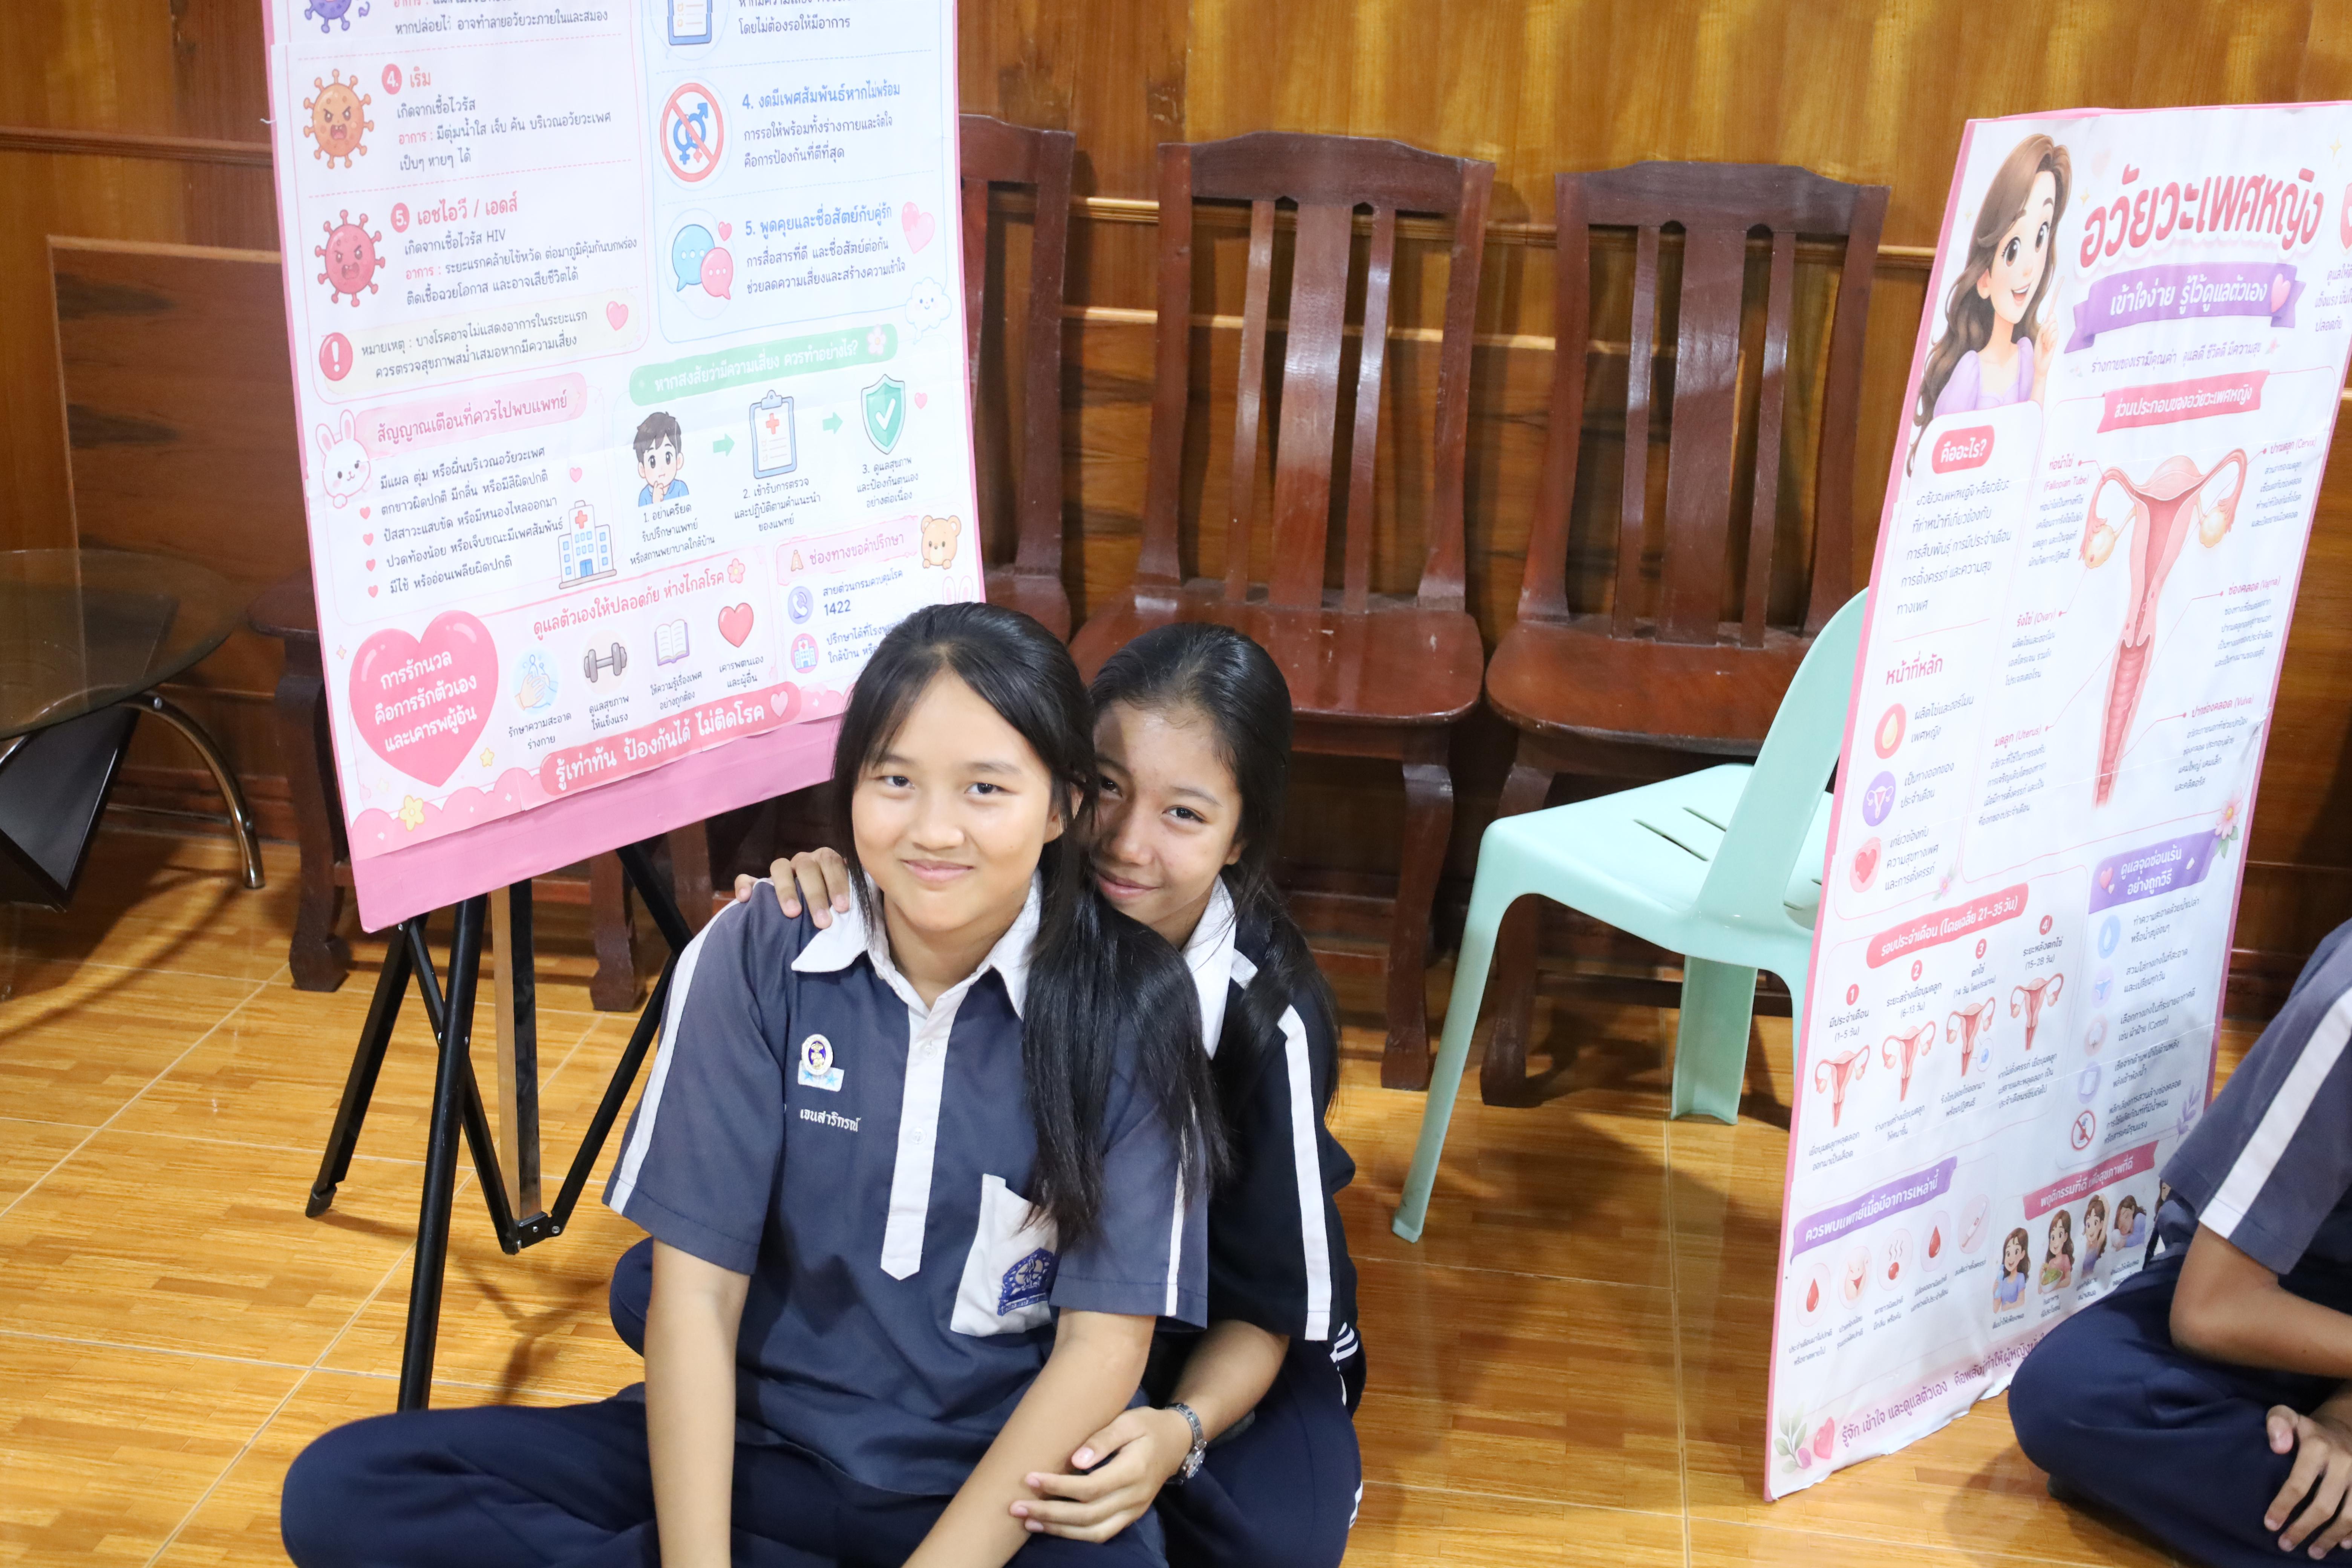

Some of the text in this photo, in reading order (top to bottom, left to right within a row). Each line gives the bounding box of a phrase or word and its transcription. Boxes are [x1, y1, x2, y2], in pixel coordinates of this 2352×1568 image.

[458, 9, 608, 30] อาจทำลายอวัยวะภายในและสมอง
[739, 15, 851, 35] โดยไม่ต้องรอให้มีอาการ
[410, 67, 431, 87] เริม
[397, 95, 476, 118] เกิดจากเชื้อไวรัส
[742, 80, 900, 109] 4. งดมีเพศสัมพันธ์หากไม่พร้อม
[399, 112, 611, 144] อาการ มีตุ่มน้ำใส เจ็บ คัน บริเวณอวัยวะเพศ
[744, 111, 893, 141] การรอให้พร้อมทั้งร่างกายและจิตใจ
[458, 147, 471, 163] ได้
[744, 145, 844, 168] คือการป้องกันที่ดีที่สุด
[418, 198, 467, 225] เอชไอวี
[485, 190, 518, 216] เอดส์
[2080, 164, 2324, 268] อวัยวะเพศหญิง
[746, 221, 755, 236] 5.
[405, 229, 506, 255] เกิดจากเชื้อไวรัส HIV
[406, 236, 637, 279] อาการ ระยะแรกคล้ายไข้หวัด ต่อมาภูมิคุ้มกันบกพร่อง
[747, 243, 808, 268] การสื่อสารที่ดี
[407, 266, 578, 305] ติดเชื้อฉวยโอกาส และอาจเสียชีวิตได้
[747, 259, 906, 294] ช่วยลดความเสี่ยงและสร้างความเข้าใจ
[2110, 274, 2267, 315] เข้าใจง่าย รู้ไว้ดูแลตัวเอง
[361, 311, 587, 357] หมายเหตุ บางโรคอาจไม่แสดงอาการในระยะแรก
[375, 330, 577, 379] ควรตรวจสุขภาพสม่ำเสมอหากมีความเสี่ยง
[2228, 341, 2262, 358] มีความสุข
[655, 339, 859, 392] หากสงสัยว่ามีความเสี่ยง ควรทำอย่างไร?
[2115, 385, 2252, 418] ส่วนประกอบของอวัยวะเพศหญิง
[377, 390, 568, 444] สัญญาณเตือนที่ควรไปพบแพทย์
[1941, 438, 1987, 463] คืออะไร?
[2049, 453, 2074, 471] ท่อนำไข่
[380, 447, 545, 490] มีแผล ตุ่ม หรือผื่นบริเวณอวัยวะเพศ
[862, 455, 912, 476] 3. ดูแลสุขภาพ
[381, 469, 548, 516] ตกขาวผิดปกติ มีกลิ่น หรือมีสีผิดปกติ
[743, 477, 809, 499] 2. เข้ารับการตรวจ
[857, 472, 919, 493] และป้องกันตนเอง
[866, 487, 913, 508] อย่างต่อเนื่อง
[384, 496, 557, 542] ปัสสาวะแสบขัด หรือมีหนองไหลออกมา
[644, 503, 691, 522] 1. อย่าเครียด
[758, 514, 794, 531] ของแพทย์
[386, 518, 563, 568] ปวดท้องน้อย หรือเจ็บขณะมีเพศสัมพันธ์
[630, 535, 715, 565] หรือสถานพยาบาลใกล้บ้าน
[809, 533, 904, 565] ช่องทางขอคำปรึกษา
[1949, 559, 1992, 579] และความสุข
[823, 568, 903, 597] สายด่วนกรมควบคุมโรค
[534, 569, 724, 641] ดูแลตัวเองให้ปลอดภัย ห่างไกลโรค
[824, 600, 851, 616] 1422
[1897, 599, 1928, 615] ทางเพศ
[719, 656, 763, 674] เคารพตนเอง
[828, 648, 859, 663] ใกล้บ้าน
[1886, 651, 1943, 685] หน้าที่หลัก
[380, 651, 452, 690] การรักนวล
[727, 670, 757, 690] และผู้อื่น
[375, 675, 477, 725] คือการรักตัวเอง
[589, 695, 629, 715] ดูแลสุขภาพ
[660, 691, 695, 711] อย่างถูกต้อง
[508, 712, 572, 738] รักษาความสะอาด
[591, 713, 628, 731] ให้แข็งแรง
[1911, 726, 1941, 743] เพศหญิง
[528, 734, 556, 750] ร่างกาย
[556, 701, 764, 791] รู้เท่าทัน ป้องกันได้ ไม่ติดโรค
[2121, 845, 2182, 877] ดูแลจุดซ่อนเร้น
[1881, 923, 1937, 957] รอบประจำเดือน
[2003, 896, 2018, 916] วัน)
[1978, 944, 1984, 955] 3
[1914, 966, 1920, 977] 2
[1850, 988, 1856, 1001] 1
[1805, 1169, 1940, 1243] ควรพบแพทย์เมื่อมีอาการเหล่านี้
[1842, 1380, 1948, 1447] รู้จัก เข้าใจ และดูแลตัวเอง
